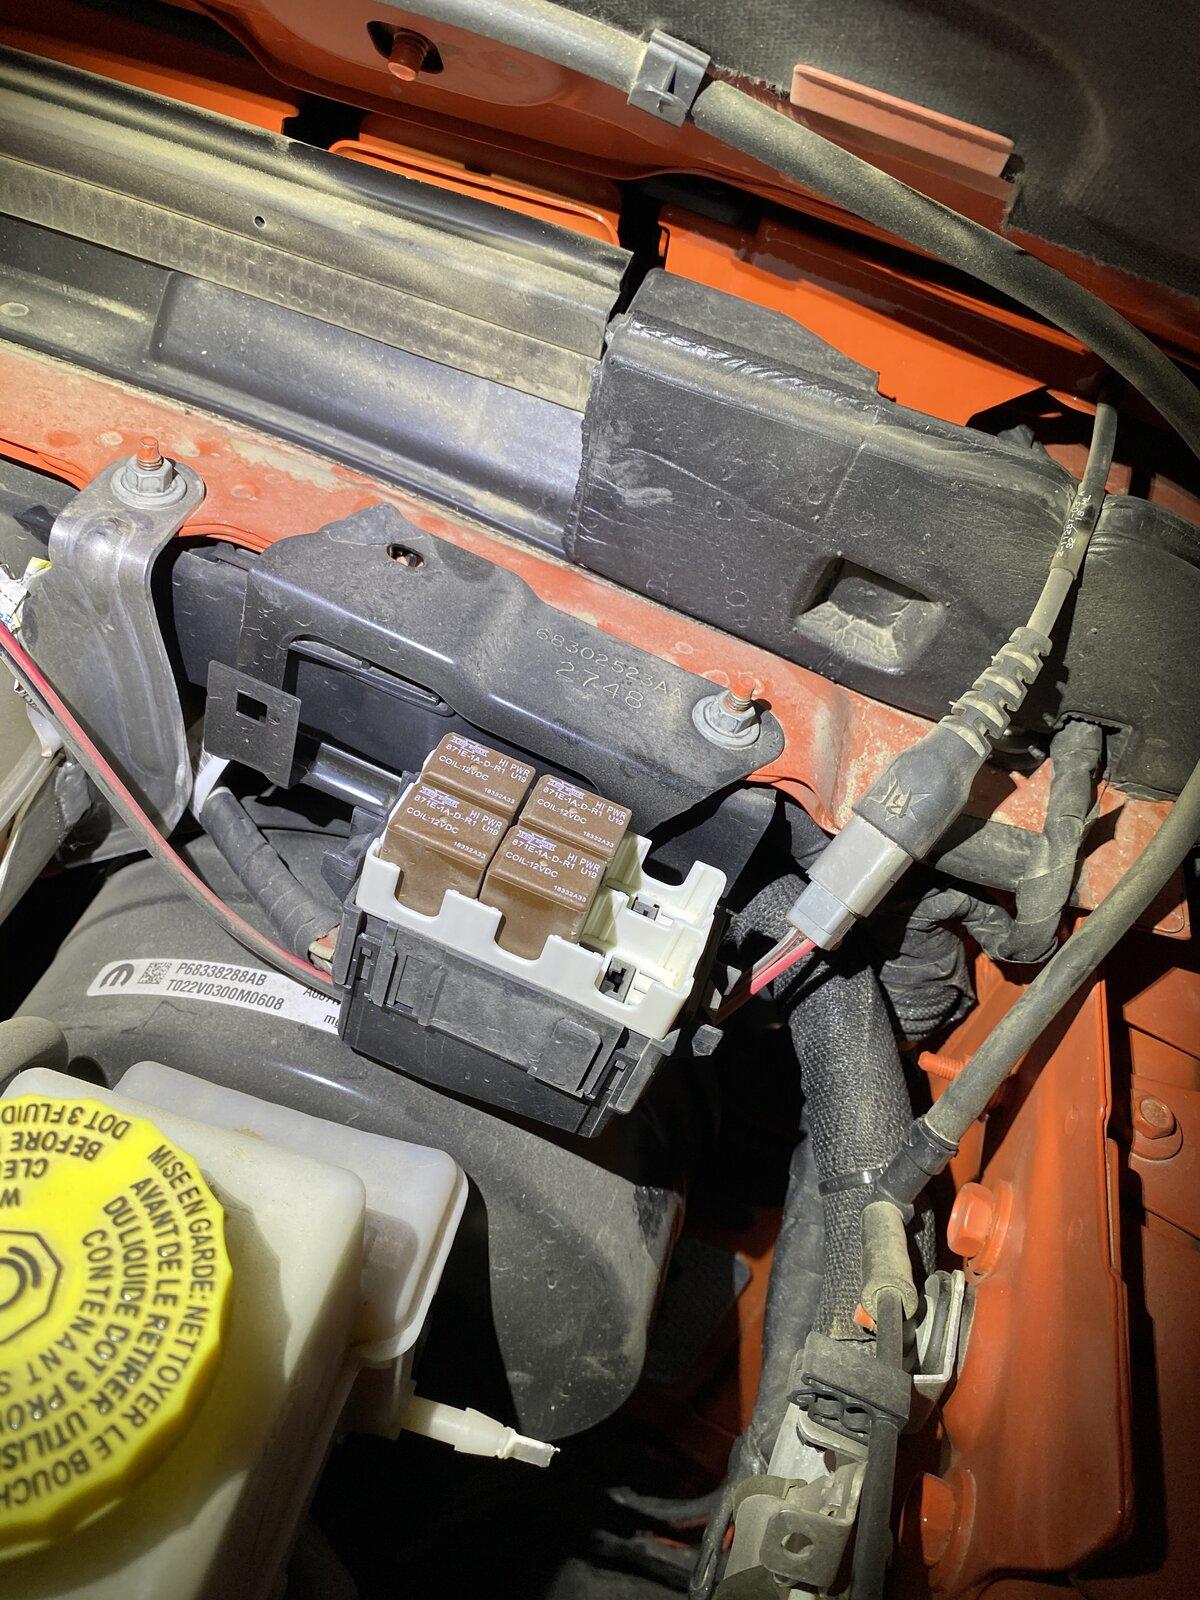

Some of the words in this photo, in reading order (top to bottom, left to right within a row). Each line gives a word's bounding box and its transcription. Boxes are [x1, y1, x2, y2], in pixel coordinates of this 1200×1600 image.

[555, 661, 644, 709] 2748
[498, 758, 509, 767] HI
[510, 764, 530, 778] PWR
[510, 773, 527, 783] U19
[469, 810, 480, 819] HI
[481, 815, 503, 829] PWR
[595, 801, 605, 810] HI
[606, 805, 627, 820] PWR
[608, 815, 624, 826] U19
[482, 826, 499, 836] U19
[567, 852, 578, 862] HI
[579, 858, 601, 873] PWR
[580, 868, 598, 879] U19
[175, 962, 268, 987] P68338288AB
[166, 978, 285, 1011] T022V0300M0608
[1, 1103, 66, 1125] FLUID
[67, 1106, 84, 1126] 3
[84, 1111, 133, 1141] DOT
[10, 1131, 104, 1161] BEFORE
[1, 1158, 49, 1179] CLE
[148, 1144, 192, 1189] MISE
[102, 1196, 139, 1228] DU
[129, 1177, 179, 1237] AVANT
[177, 1185, 209, 1217] EN
[114, 1226, 149, 1318] LIQUIDE
[156, 1242, 182, 1273] DE
[27, 1229, 114, 1385] CONTENANT
[152, 1279, 181, 1308] LE
[84, 1324, 130, 1376] DOT
[122, 1305, 209, 1429] NETTOYER
[0, 1385, 66, 1431] PRO
[0, 1411, 88, 1470] UTILIS
[91, 1423, 127, 1460] LE
